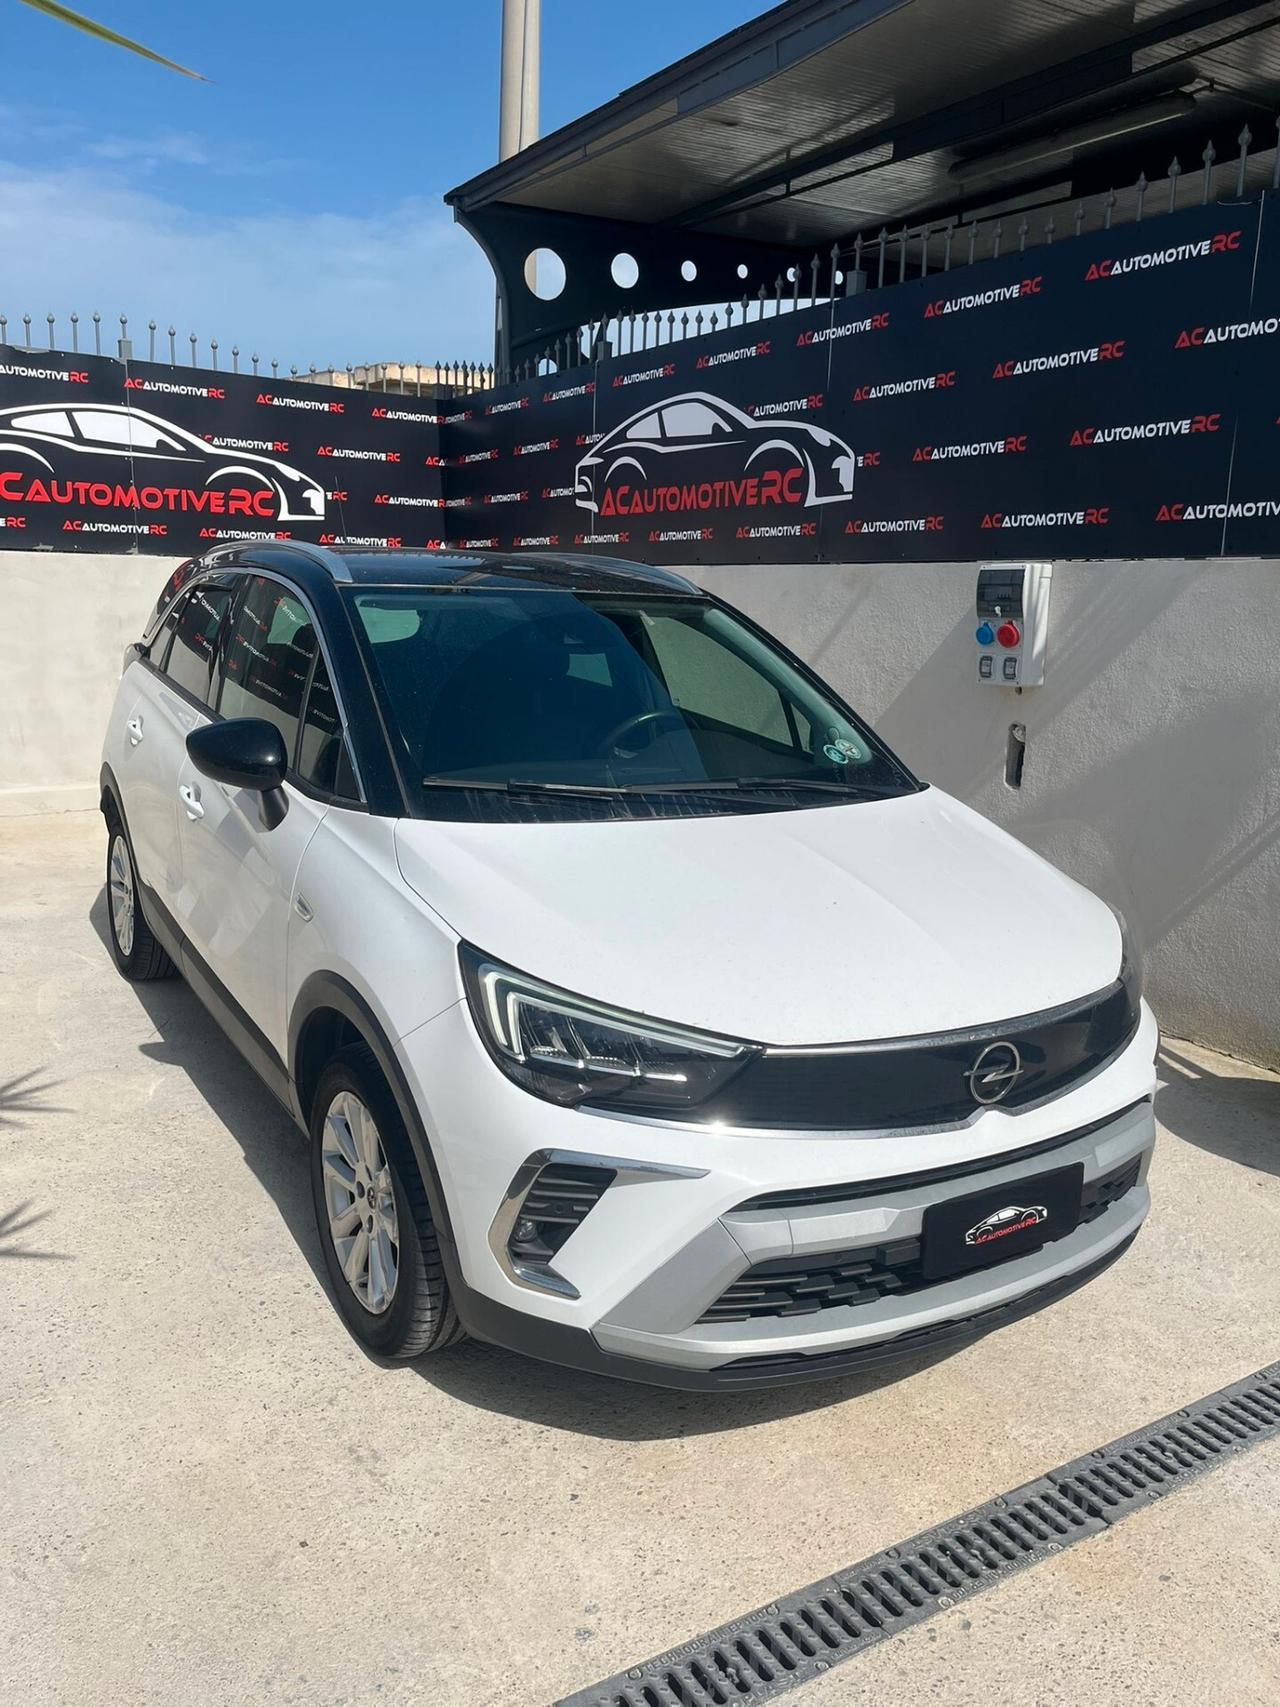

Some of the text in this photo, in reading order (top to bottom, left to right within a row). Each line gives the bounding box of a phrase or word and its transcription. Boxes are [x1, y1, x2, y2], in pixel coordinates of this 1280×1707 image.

[1085, 231, 1242, 280] ACAUTOMOTIVERC
[924, 276, 1042, 318] ACAUTOMOTIVERC
[796, 312, 889, 346] ACAUTOMOTIVERC
[696, 341, 771, 368] ACAUTOMOTIVERC
[993, 341, 1125, 378] ACAUTOMOTIVERC
[612, 363, 676, 387] ACAUTOMOTIVERC
[124, 378, 224, 399] ACAUTOMOTIVERC
[543, 382, 595, 403] ACAUTOMOTIVERC
[853, 371, 956, 401] ACAUTOMOTIVERC
[256, 393, 344, 413] ACAUTOMOTIVERC
[485, 397, 529, 416] ACAUTOMOTIVERC
[744, 394, 824, 417] AUTOMOTIVERC
[1070, 414, 1221, 446] ACAUTOMOTIVERC
[317, 446, 400, 462] ACAUTOMOTIVERC
[513, 438, 559, 456] ACAUTOMOTIVERC
[912, 436, 1027, 462] ACAUTOMOTIVERC
[856, 452, 880, 467] ERC
[600, 468, 803, 516] ACAUTOMOTIVERC
[63, 520, 167, 535] ACAUTOMOTIVERC
[845, 516, 944, 534] ACAUTOMOTIVERC
[981, 508, 1109, 529] ACAUTOMOTIVERC
[513, 535, 559, 546] ACAUTOMOTIVERC
[574, 532, 630, 544] ACAUTOMOTIVERC
[648, 528, 713, 541] ACAUTOMOTIVERC
[736, 523, 816, 537] ACAUTOMOTIVERC
[976, 1217, 1036, 1245] ACAUTOMOTIVERC
